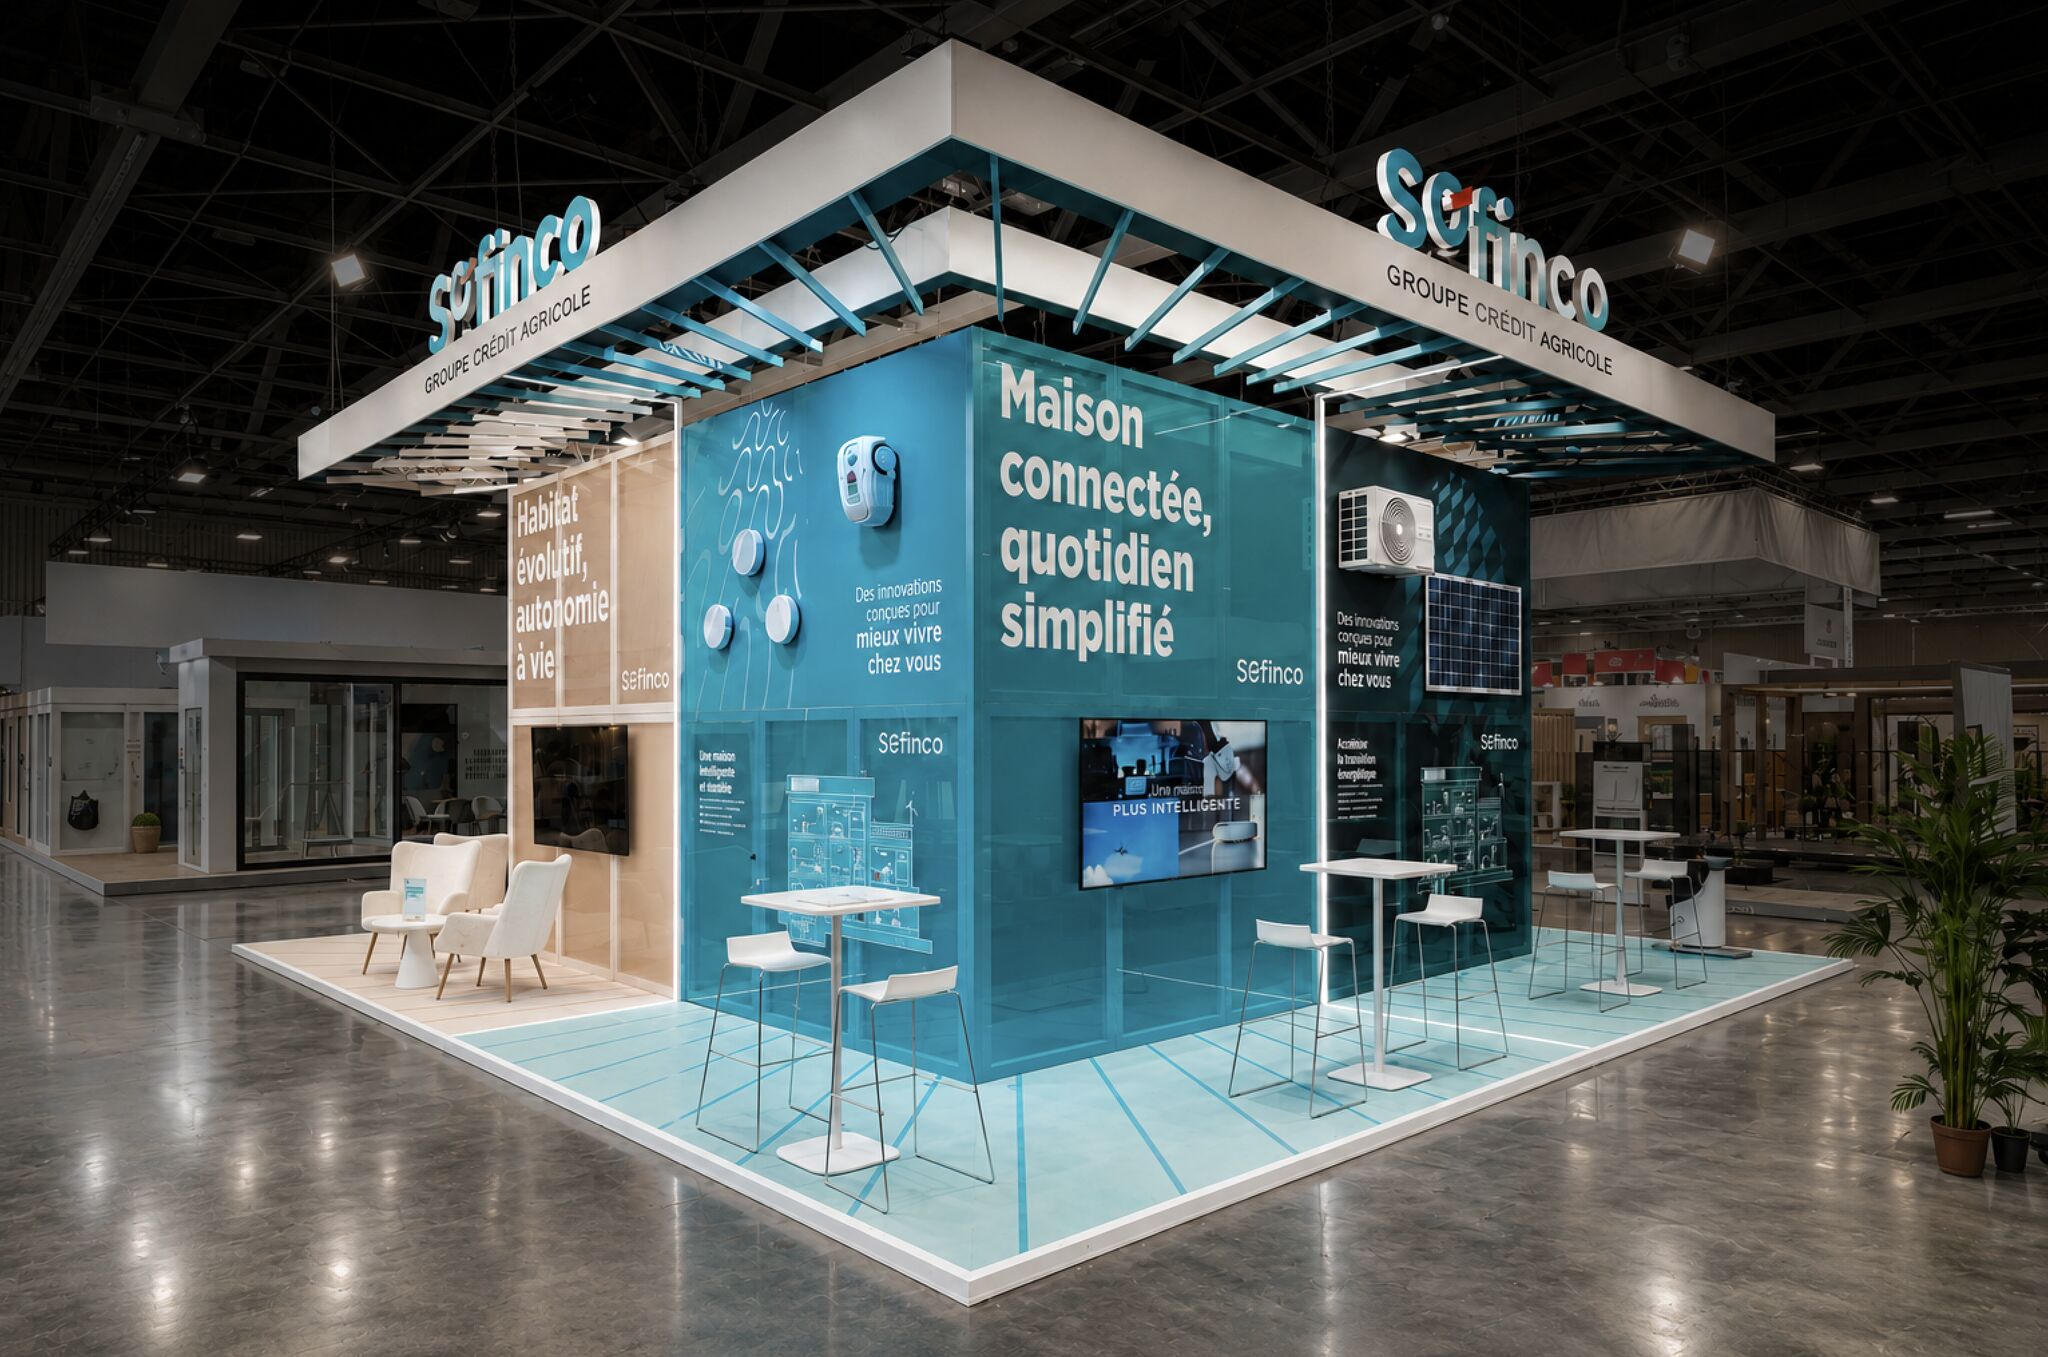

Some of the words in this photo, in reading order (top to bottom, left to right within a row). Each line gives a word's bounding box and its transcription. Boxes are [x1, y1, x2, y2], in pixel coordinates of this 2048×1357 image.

[1387, 264, 1469, 315] GROUPE
[1475, 302, 1536, 342] CRÉDIT
[1540, 331, 1612, 376] AGRICOLE
[425, 355, 470, 394] GROUPE
[473, 327, 518, 366] CRÉDIT
[520, 285, 591, 341] AGRICOLE
[1001, 363, 1143, 448] Maison
[1000, 451, 1211, 537] connectée,
[517, 486, 579, 537] Habitat
[517, 533, 587, 585] évolutif,
[1001, 527, 1194, 592] quotidien
[855, 586, 875, 602] Des
[877, 578, 942, 599] innovations
[516, 581, 609, 633] autonomie
[866, 602, 910, 624] conçues
[913, 600, 940, 618] pour
[1337, 611, 1353, 626] Des
[856, 626, 899, 648] mieux
[904, 621, 942, 645] vivre
[1001, 591, 1174, 662] simplifié
[1374, 635, 1393, 648] pour
[516, 642, 526, 681] à
[530, 641, 555, 679] vie
[868, 653, 901, 674] chez
[906, 654, 941, 673] vous
[1338, 647, 1372, 666] mieux
[1374, 650, 1400, 668] vivre
[1338, 667, 1364, 687] chez
[1366, 674, 1391, 689] vous
[1113, 803, 1147, 816] PLUS
[1152, 797, 1241, 814] INTELLIGENTE
[1151, 783, 1171, 797] Une
